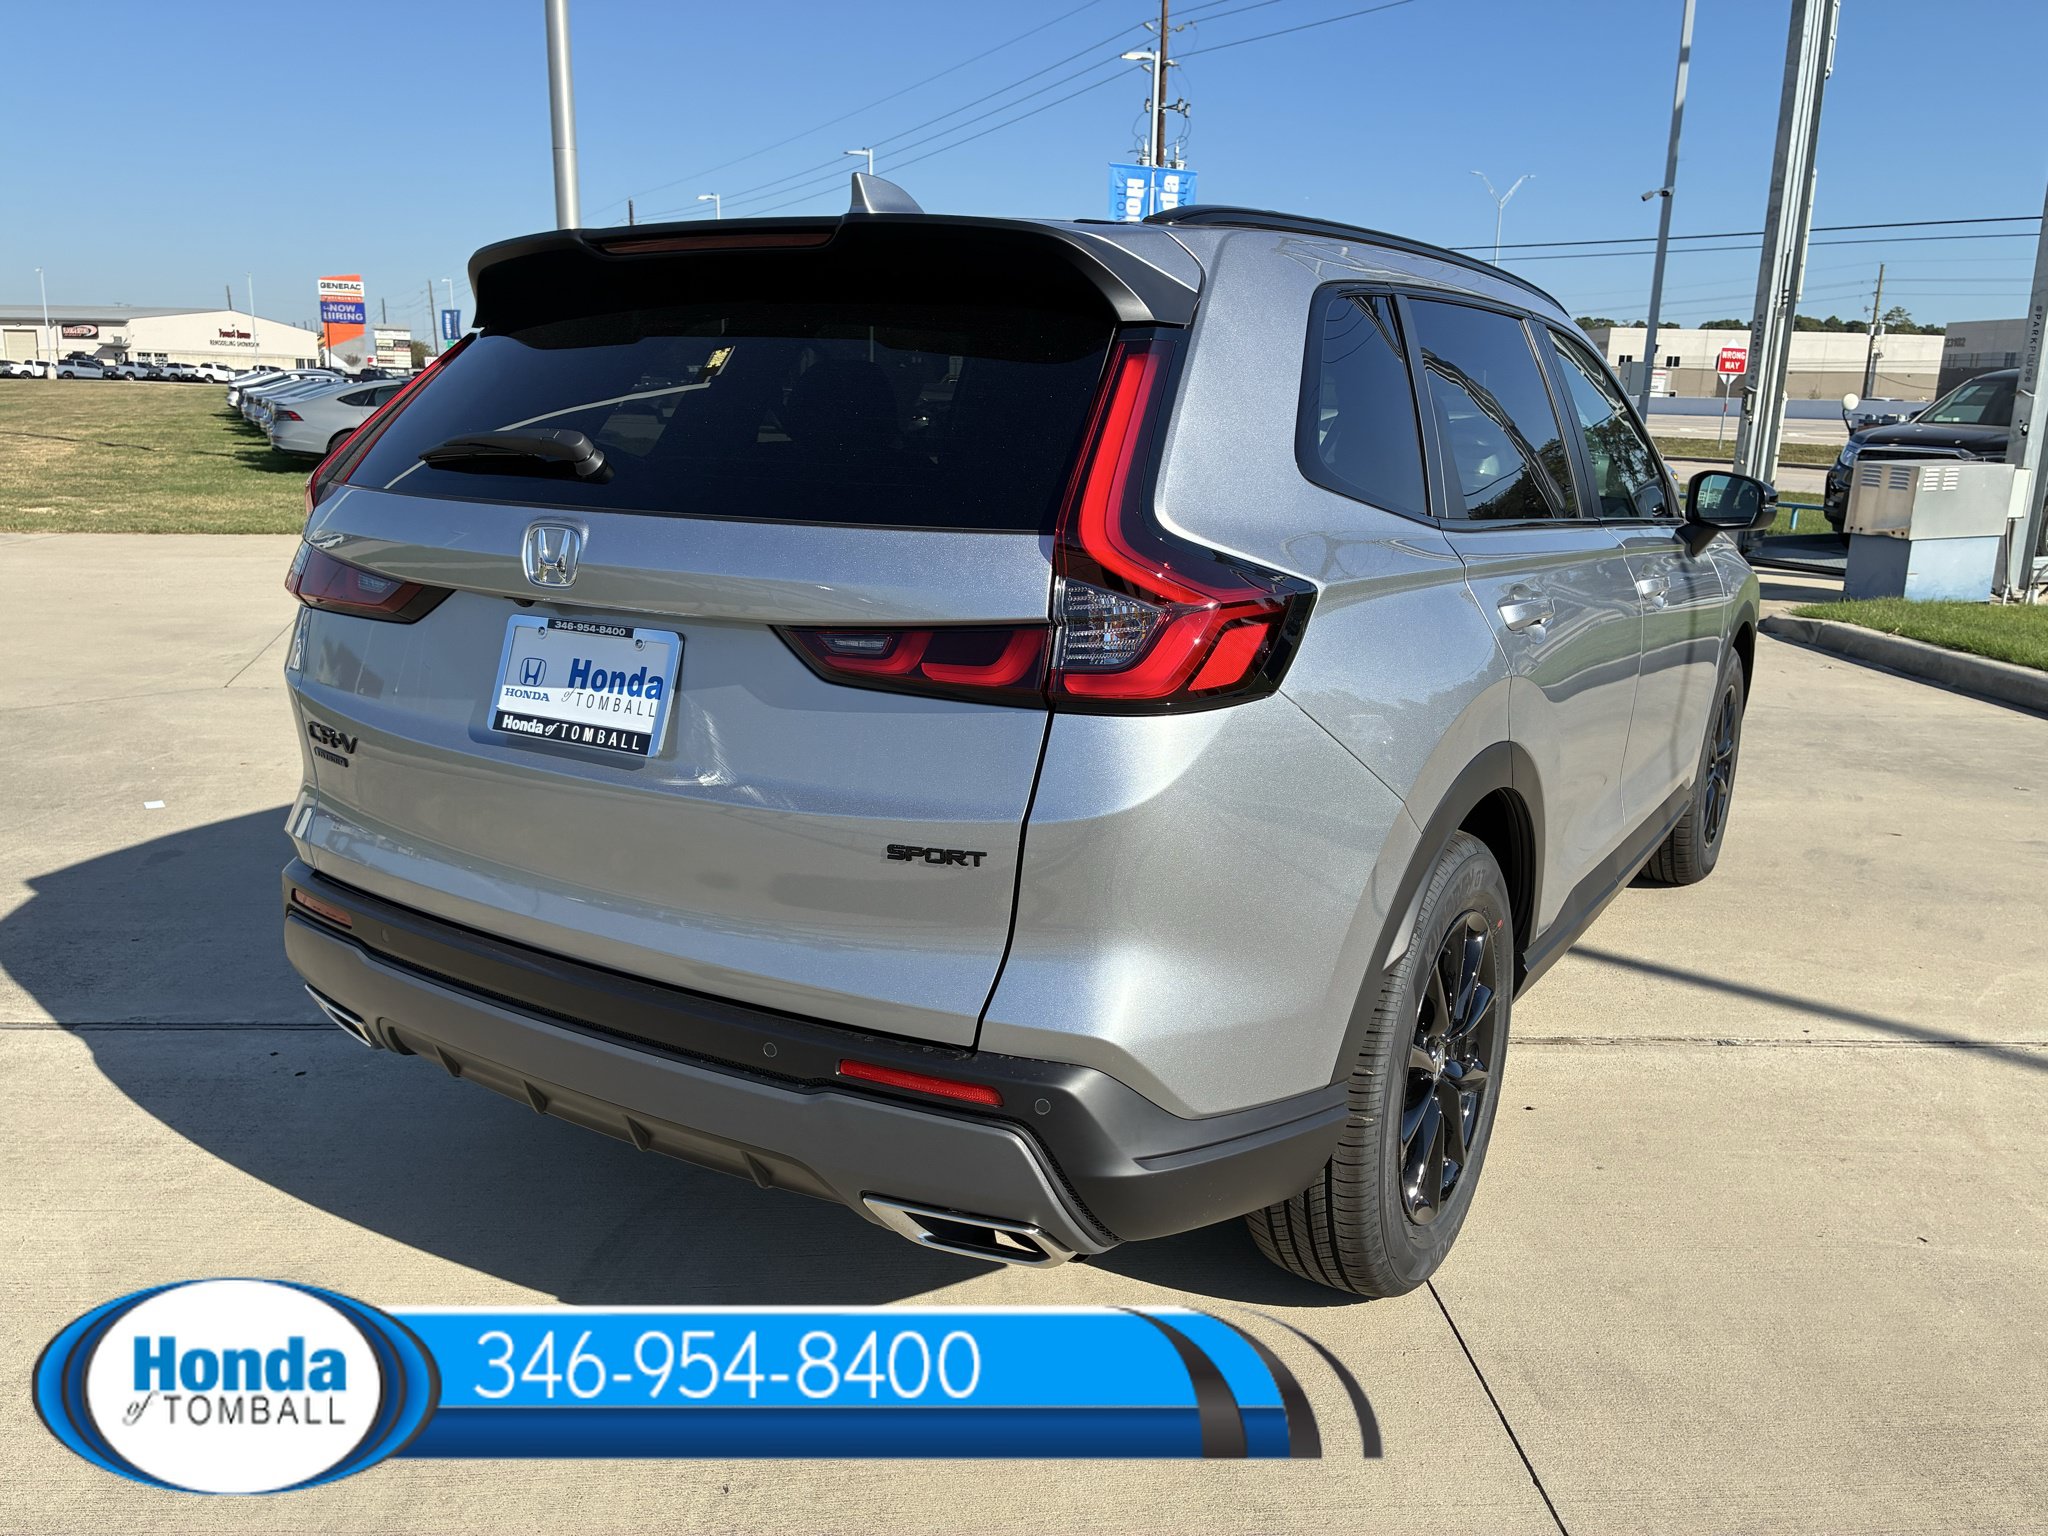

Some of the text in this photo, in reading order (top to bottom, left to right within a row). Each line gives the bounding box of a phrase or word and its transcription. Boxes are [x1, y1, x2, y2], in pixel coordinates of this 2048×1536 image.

[320, 282, 361, 290] GENERAC
[323, 311, 363, 321] HIRING
[329, 304, 356, 312] NOW
[1722, 351, 1746, 360] WRONG
[1724, 361, 1741, 370] WAY
[554, 619, 626, 637] 346-954-8400
[567, 657, 664, 700] Honda
[504, 687, 550, 702] HONDA
[560, 687, 655, 718] of TOMBALL
[307, 720, 359, 754] CR-V
[502, 714, 640, 751] Honda of TOMBALL
[886, 843, 988, 867] SPORT
